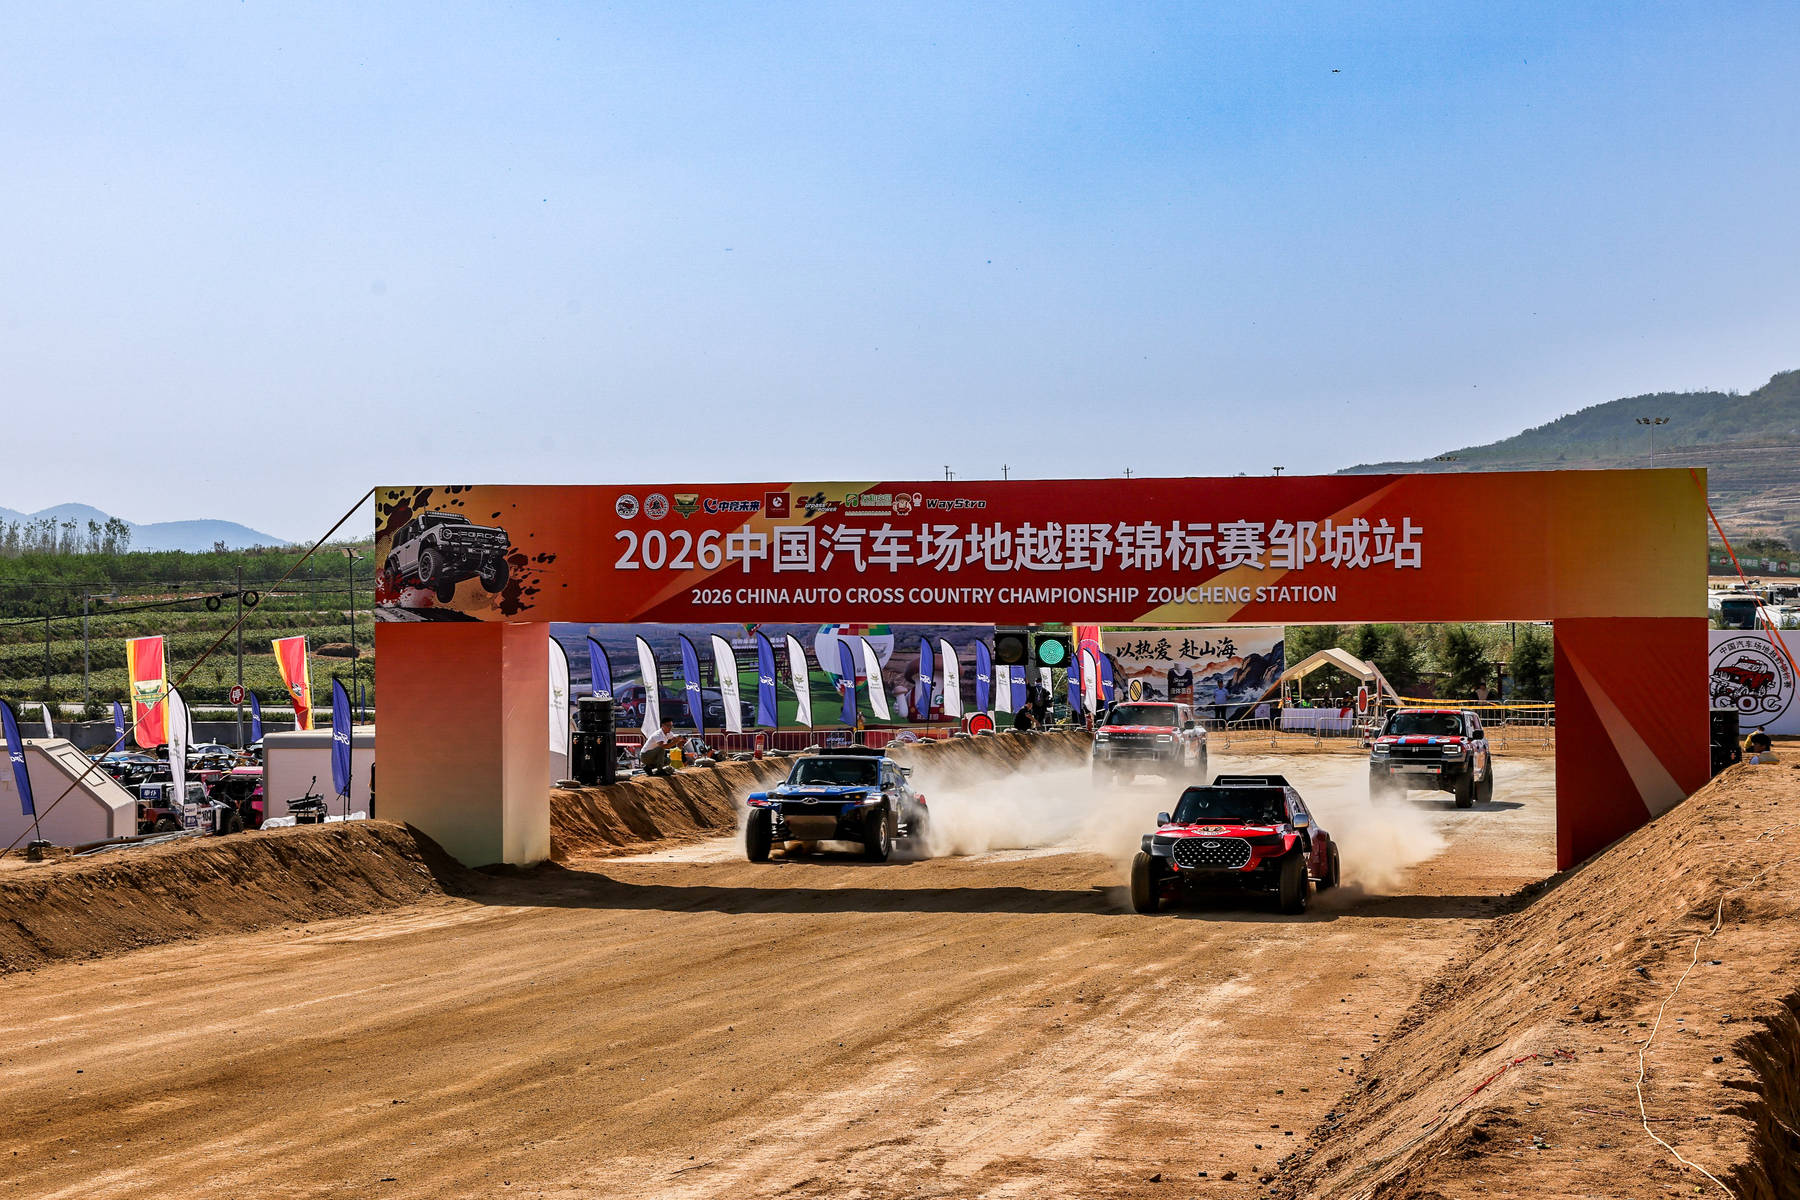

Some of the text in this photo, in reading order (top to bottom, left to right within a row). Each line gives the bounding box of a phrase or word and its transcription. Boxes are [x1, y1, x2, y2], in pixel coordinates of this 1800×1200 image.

[614, 517, 1424, 574] 2026中国汽车场地越野锦标赛邹城站
[691, 585, 1337, 604] 2026 CHINA AUTO CROSS COUNTRY CHAMPIONSHIP ZOUCHENG STATION
[1116, 636, 1238, 662] 以热爱 赴山海
[232, 688, 242, 702] 停
